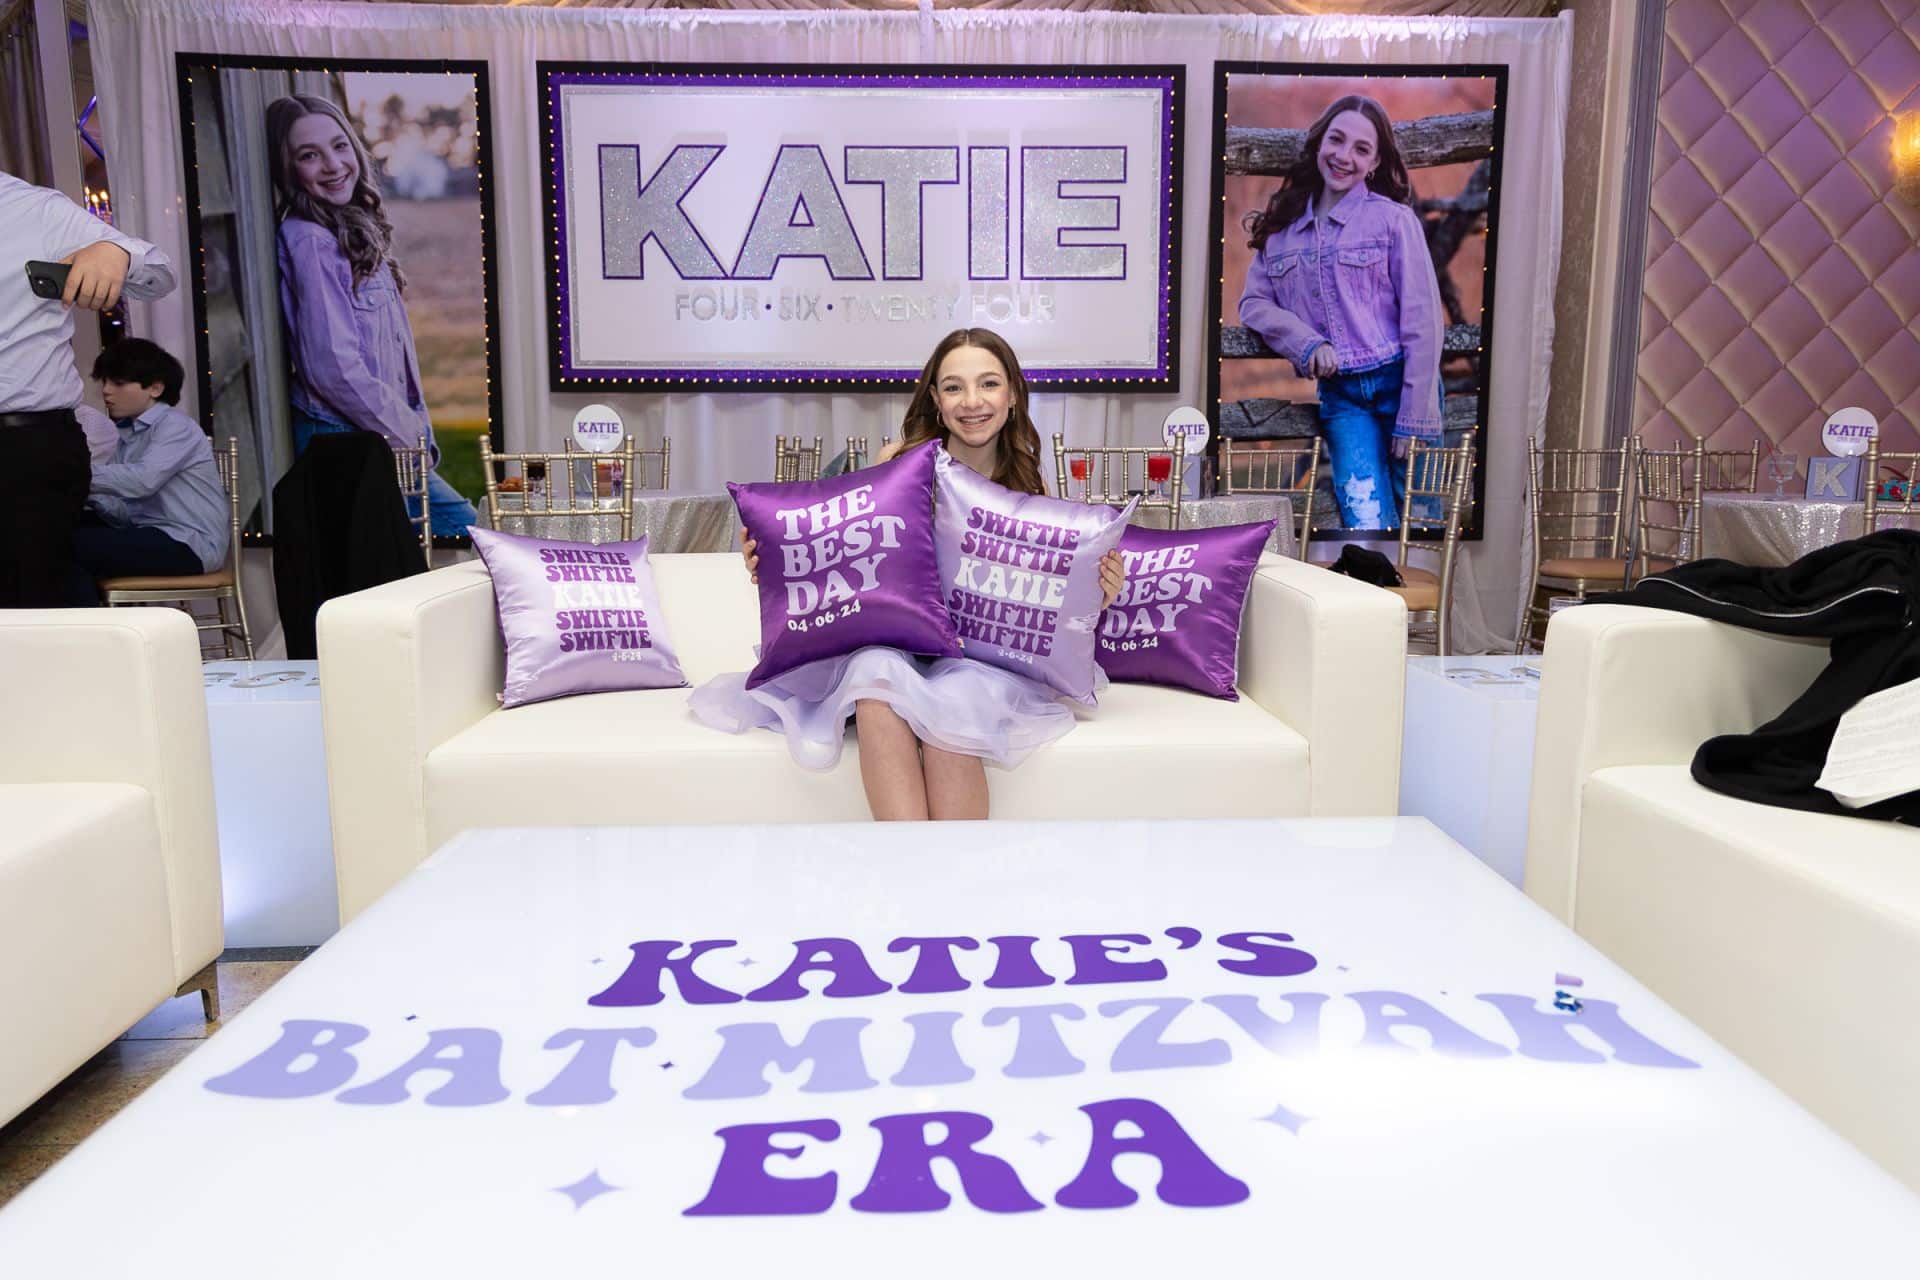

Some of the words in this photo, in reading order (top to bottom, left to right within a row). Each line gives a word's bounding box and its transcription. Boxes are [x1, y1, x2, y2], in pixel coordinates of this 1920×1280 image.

[598, 143, 1127, 281] KATIE
[675, 293, 760, 322] FOUR
[777, 294, 823, 322] SIX
[839, 294, 962, 323] TWENTY
[971, 293, 1055, 323] FOUR
[578, 421, 620, 434] KATIE
[1168, 424, 1206, 436] KATIE
[1827, 423, 1875, 438] KATIE
[1814, 462, 1850, 497] K
[775, 484, 876, 541] THE
[967, 506, 1081, 551] SWIFTIE
[539, 548, 631, 566] SWIFTIE
[780, 515, 906, 577] BEST
[960, 531, 1074, 576] SWIFTIE
[1120, 543, 1200, 577] THE
[545, 565, 636, 583] SWIFTIE
[784, 553, 888, 616] DAY
[953, 556, 1068, 609] KATIE
[1111, 572, 1213, 607] BEST
[552, 584, 643, 609] KATIE
[949, 588, 1058, 633] SWIFTIE
[556, 609, 648, 630] SWIFTIE
[1102, 603, 1189, 638] DAY
[560, 630, 652, 653] SWIFTIE
[587, 926, 1317, 1007] KATIE'S
[202, 1019, 658, 1107] BAT
[681, 990, 1702, 1101] MITZVAH
[681, 1097, 1251, 1217] ERA
